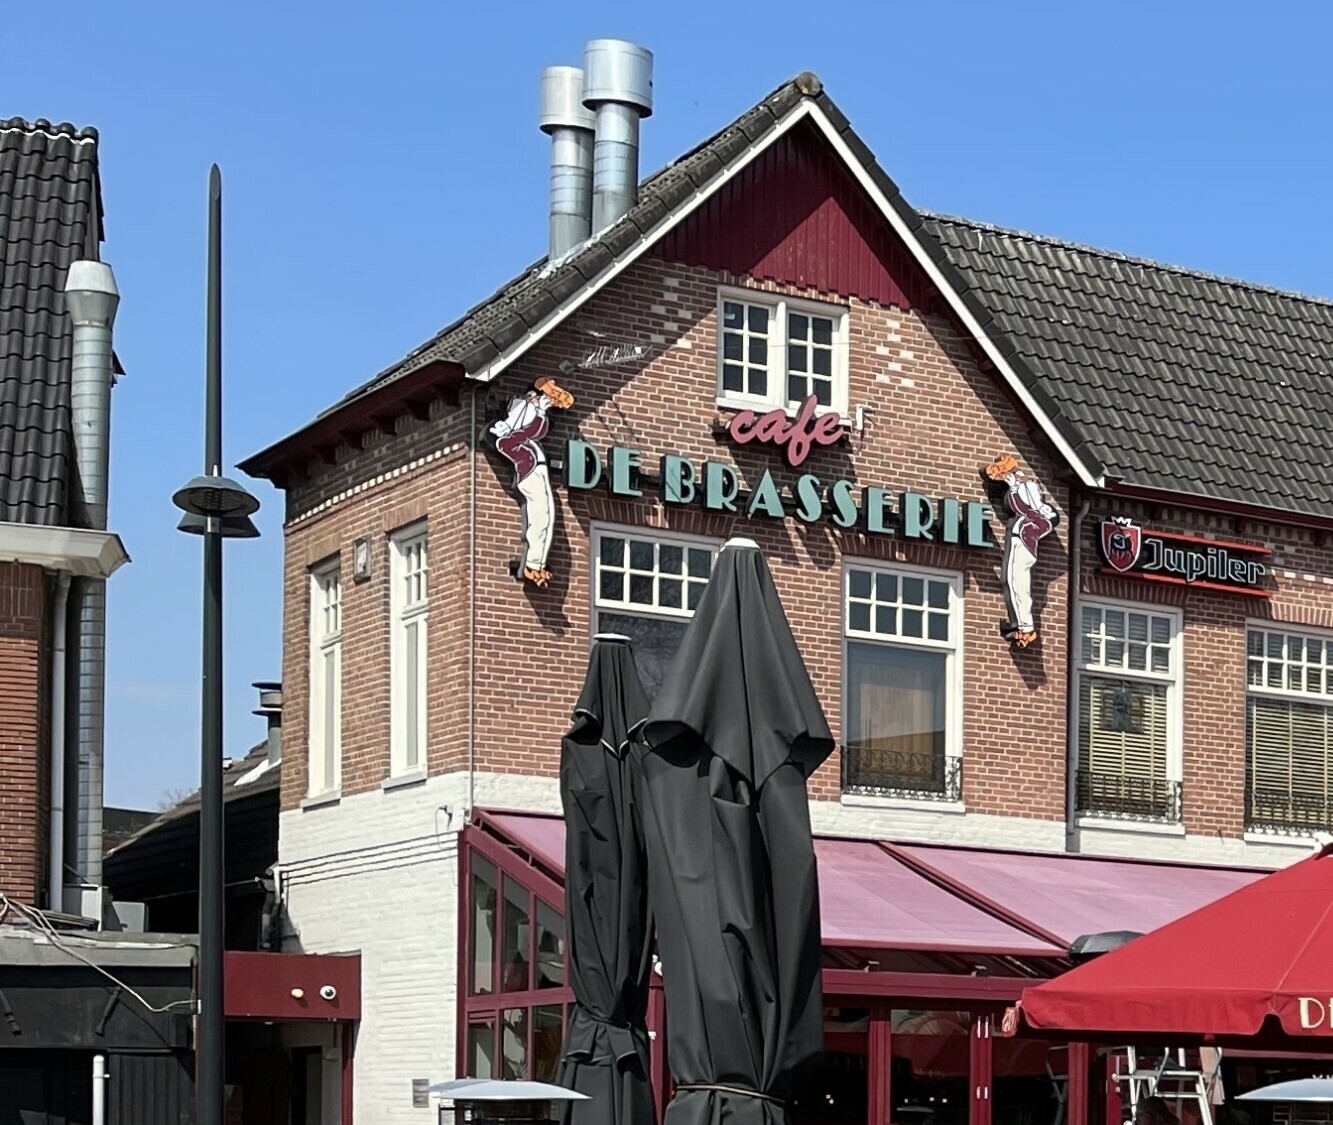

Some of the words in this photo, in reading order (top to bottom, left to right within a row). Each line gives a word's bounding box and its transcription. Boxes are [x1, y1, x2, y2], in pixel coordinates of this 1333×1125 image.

[730, 394, 845, 467] cafe
[566, 440, 642, 497] DE
[662, 455, 994, 547] BRASSERIE
[1142, 538, 1267, 584] Jupiler
